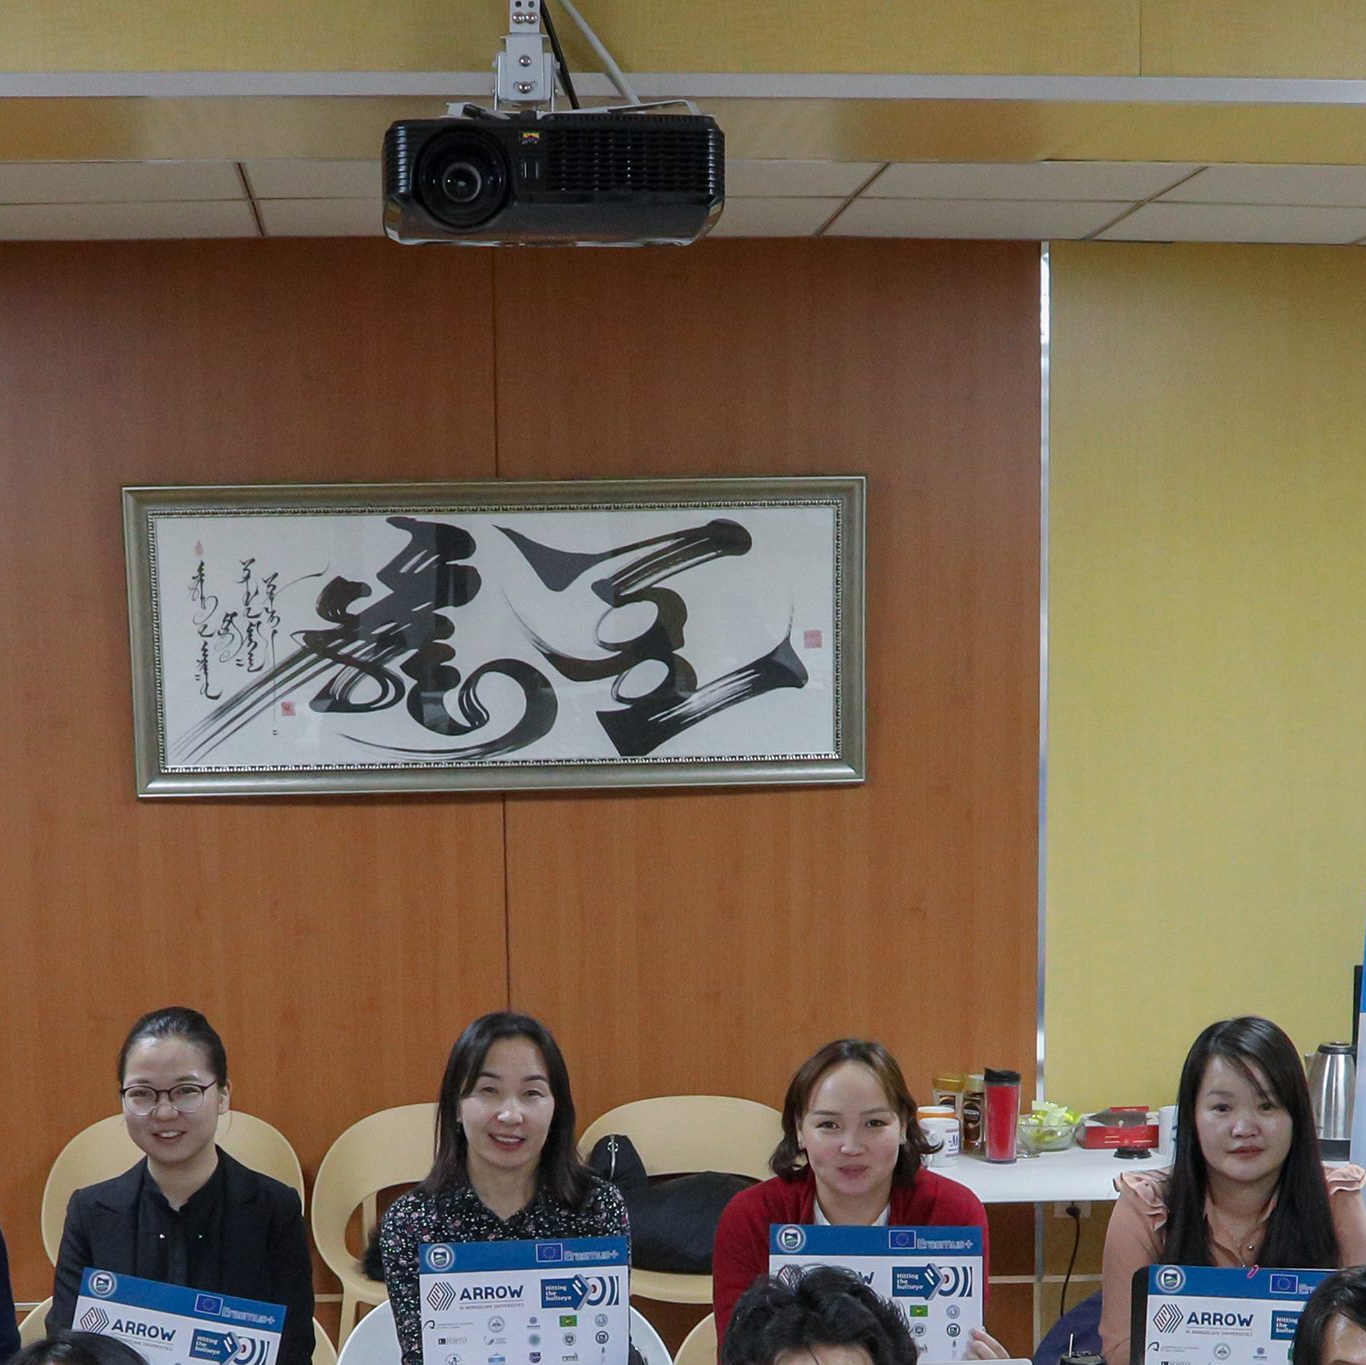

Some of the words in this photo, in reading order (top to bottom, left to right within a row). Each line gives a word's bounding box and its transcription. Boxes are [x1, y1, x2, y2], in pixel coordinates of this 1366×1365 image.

[460, 1285, 523, 1300] ARROW
[1187, 1312, 1254, 1327] ARROW
[111, 1319, 176, 1341] ARROW
